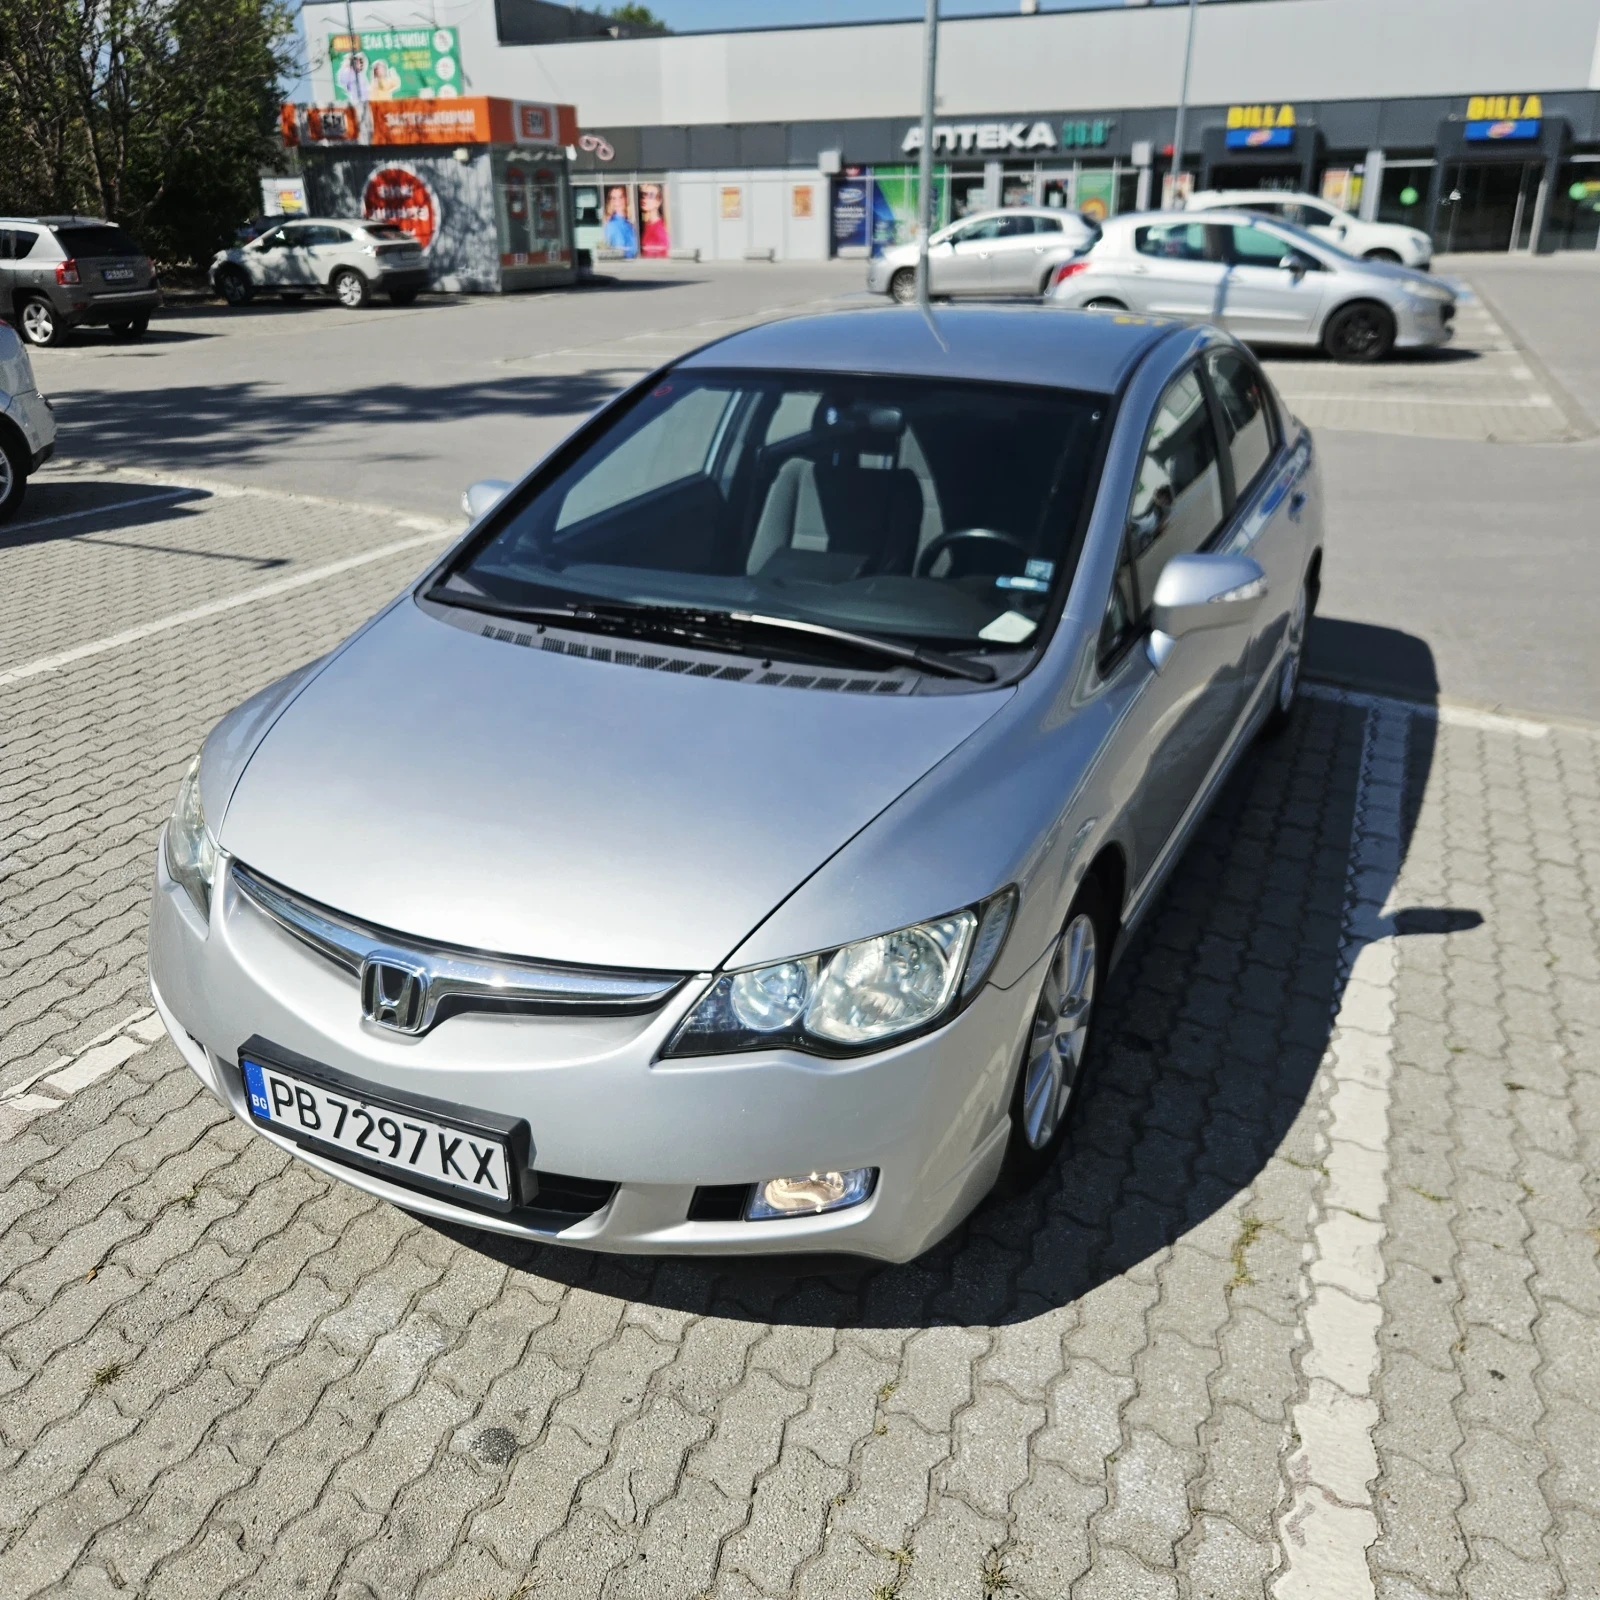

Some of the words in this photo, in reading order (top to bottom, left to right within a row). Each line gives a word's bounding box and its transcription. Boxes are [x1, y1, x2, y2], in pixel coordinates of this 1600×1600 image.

[1226, 104, 1296, 129] BILLA
[1465, 94, 1543, 120] BILLA
[901, 121, 1058, 152] АПТЕКА
[251, 1093, 268, 1110] BG
[269, 1076, 321, 1131] PB
[326, 1097, 428, 1165] 7297
[438, 1132, 499, 1190] KX
